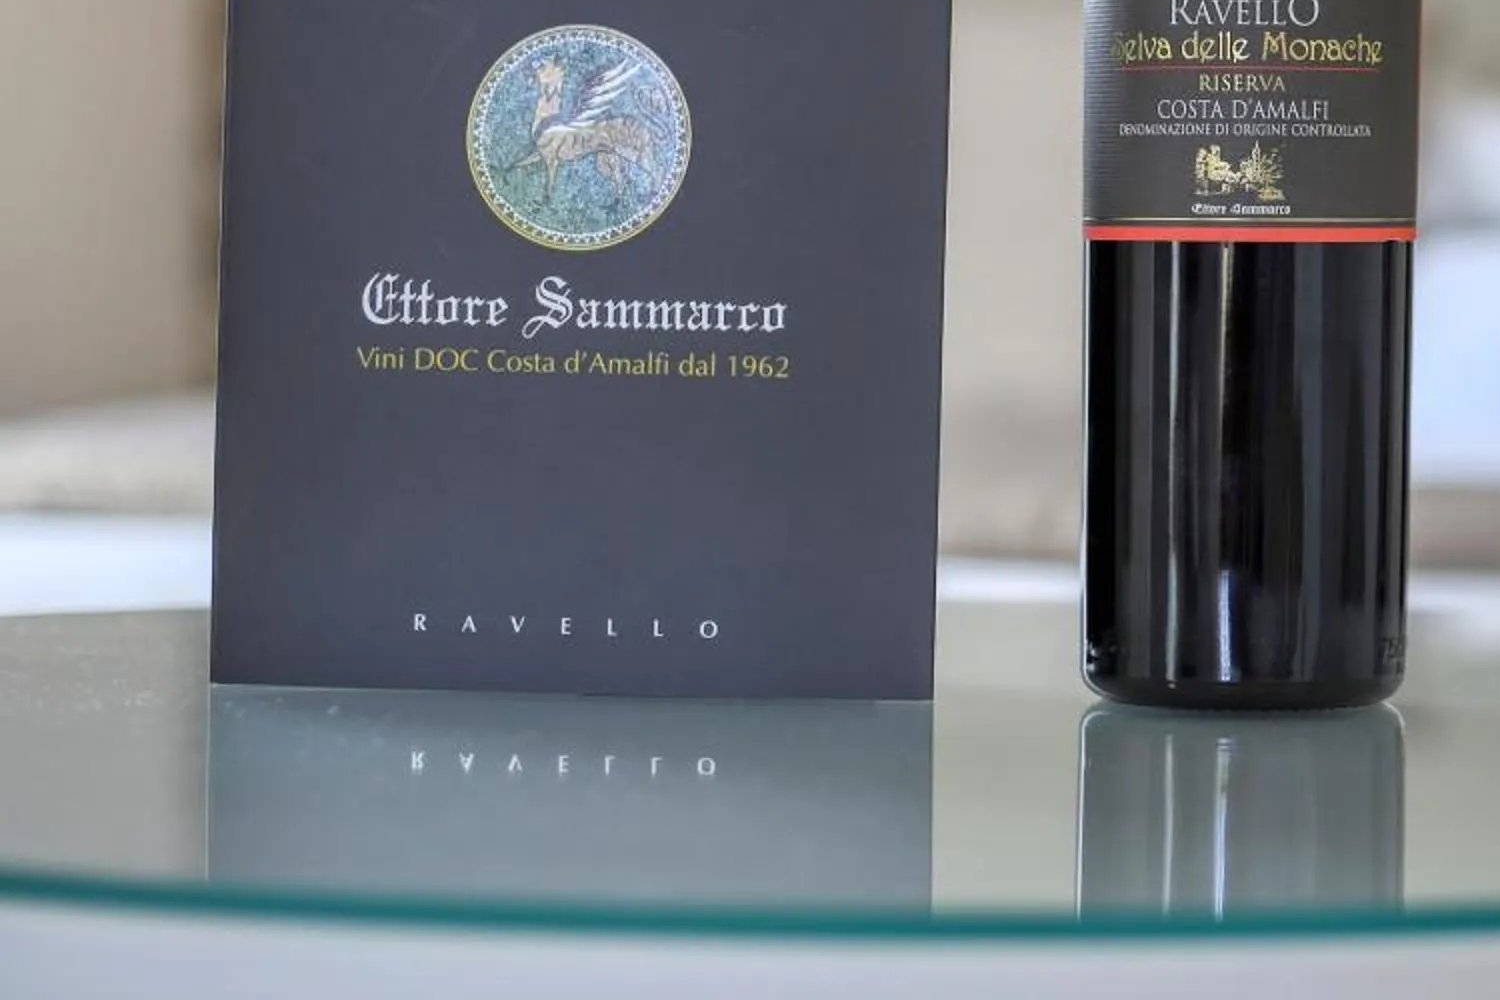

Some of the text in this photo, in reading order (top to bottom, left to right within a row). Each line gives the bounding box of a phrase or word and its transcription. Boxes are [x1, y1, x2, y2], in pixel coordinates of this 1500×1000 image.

[1181, 30, 1250, 64] delle
[1261, 31, 1382, 66] Monache
[1199, 73, 1285, 92] RISERVA
[1157, 98, 1329, 120] COSTA D'AMALFI
[1119, 123, 1371, 137] DENOMINAZIONE DI ORIGINE CONTROLLATA
[361, 272, 787, 339] Ettore Sammarco
[356, 346, 789, 379] Vini DOC Costa d'Amalfi dal 1962
